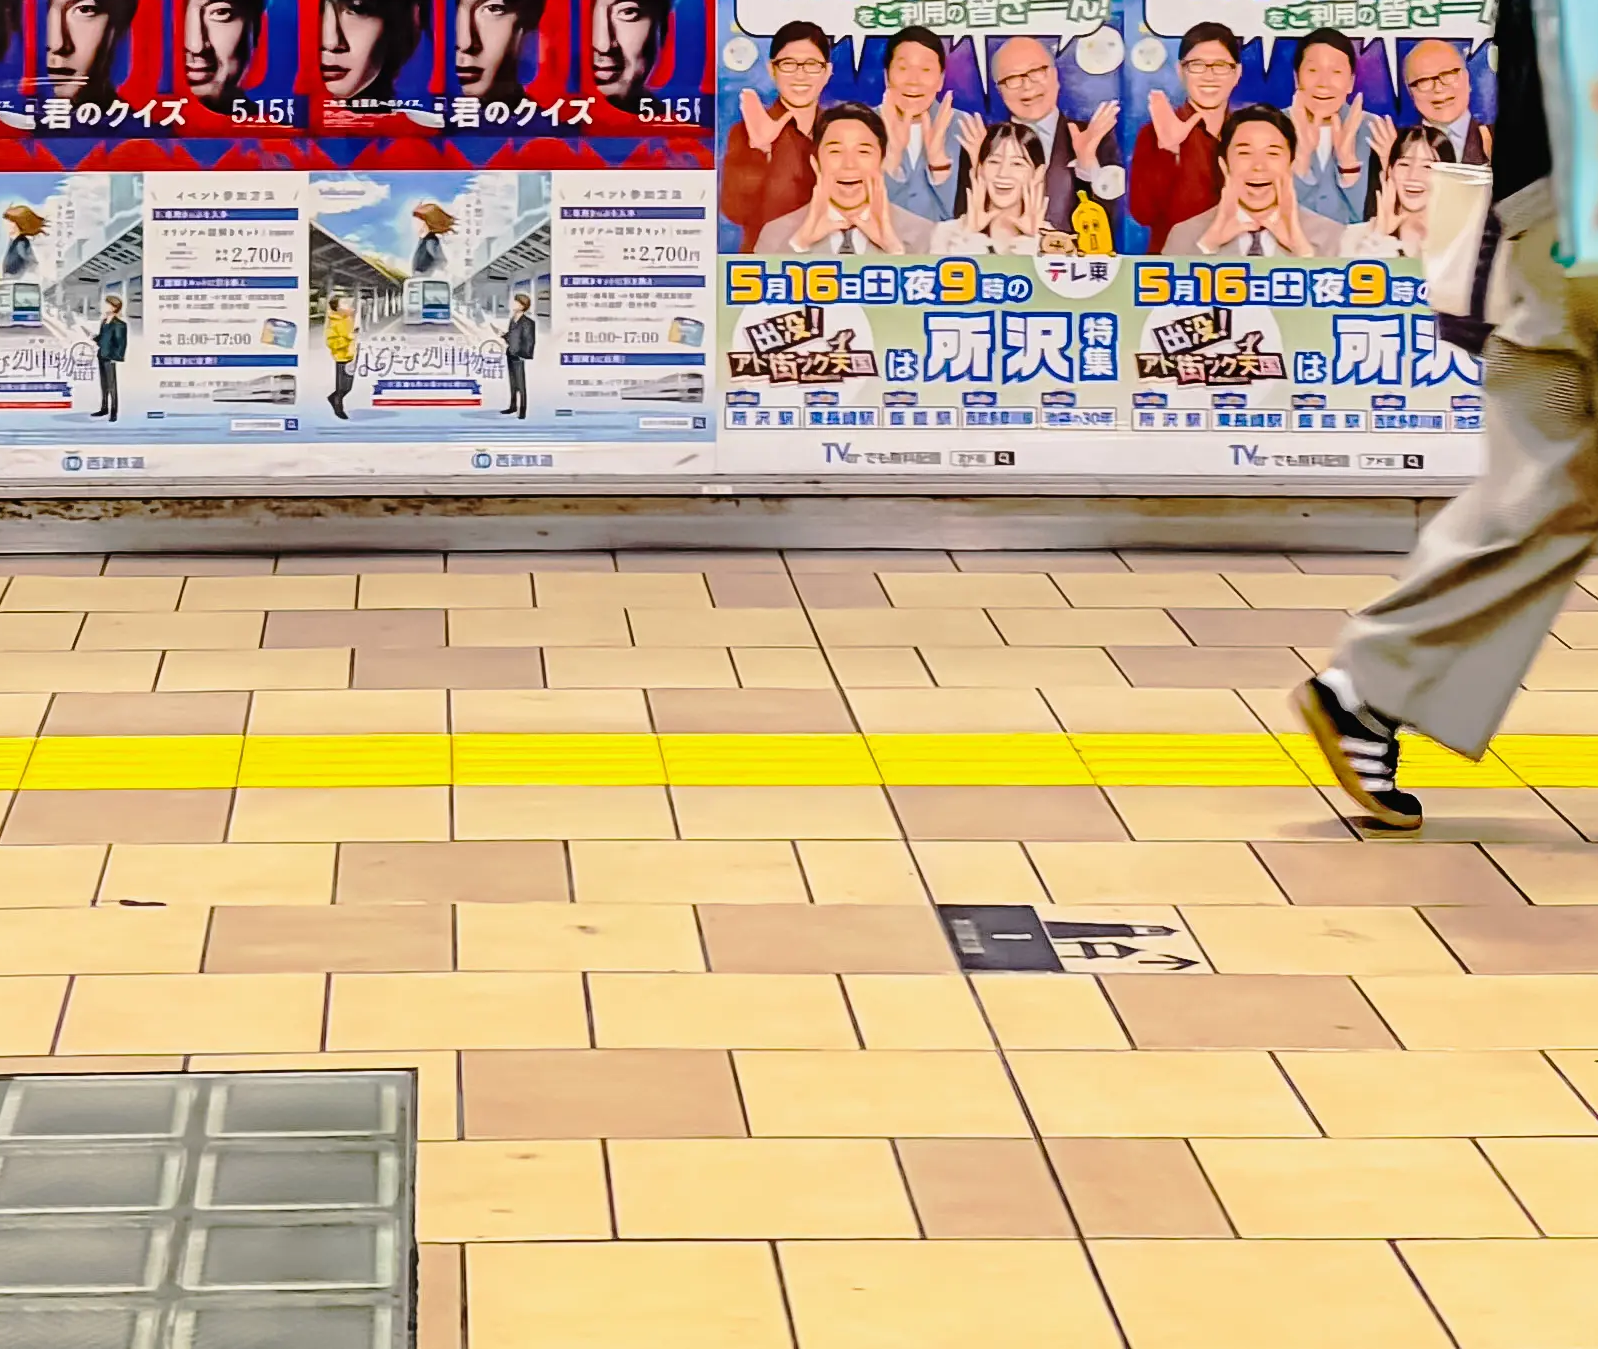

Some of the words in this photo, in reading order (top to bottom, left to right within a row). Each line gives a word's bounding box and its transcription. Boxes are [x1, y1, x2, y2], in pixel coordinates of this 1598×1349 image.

[41, 98, 189, 130] 君のクイズ
[230, 98, 284, 124] 5.15
[450, 97, 595, 129] 君のクイズ
[637, 97, 692, 123] 5.15
[231, 247, 293, 265] 2,700円
[638, 246, 701, 264] 2,700円
[1045, 260, 1111, 283] テレ東
